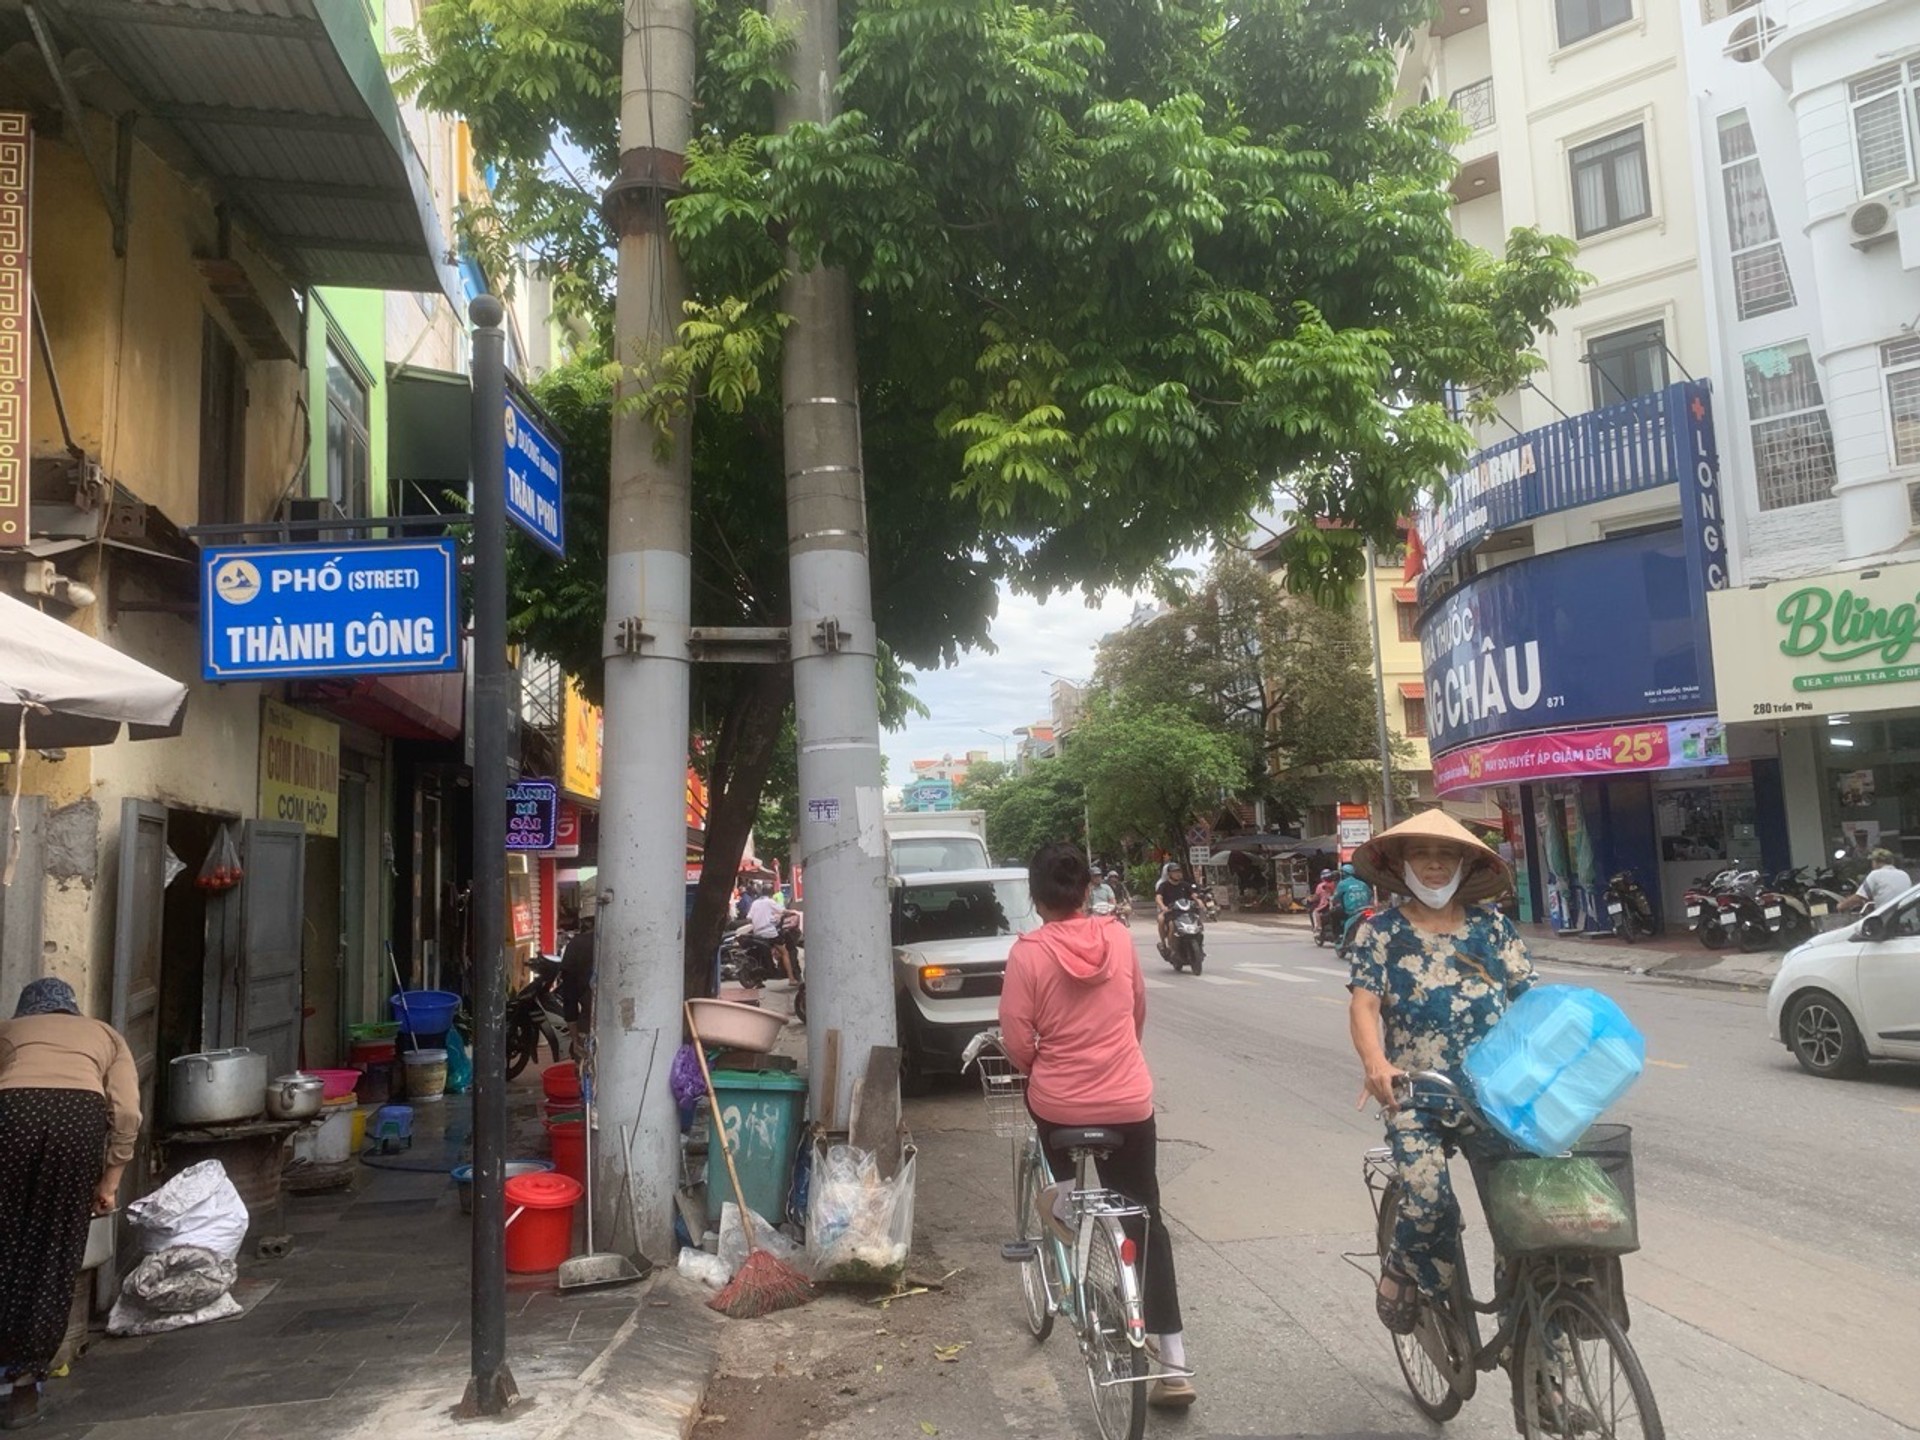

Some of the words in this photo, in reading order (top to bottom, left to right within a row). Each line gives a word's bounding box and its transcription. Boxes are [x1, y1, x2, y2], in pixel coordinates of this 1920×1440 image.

[1463, 443, 1537, 502] PHARMA
[1697, 430, 1719, 552] LONG
[271, 556, 343, 593] PHỐ
[348, 568, 419, 592] (STREET)
[227, 616, 335, 663] THÀNH
[345, 612, 435, 658] CÔNG
[1436, 594, 1474, 659] THUỐC
[1445, 636, 1542, 728] CHÂU
[1802, 678, 1822, 687] TEA
[1833, 674, 1862, 684] MILK
[1865, 672, 1887, 680] TEA
[1547, 696, 1565, 708] 871
[1753, 702, 1772, 715] 280
[1537, 749, 1550, 766] ÁP
[1552, 746, 1584, 764] GIẢM
[1586, 743, 1612, 762] ĐẾN
